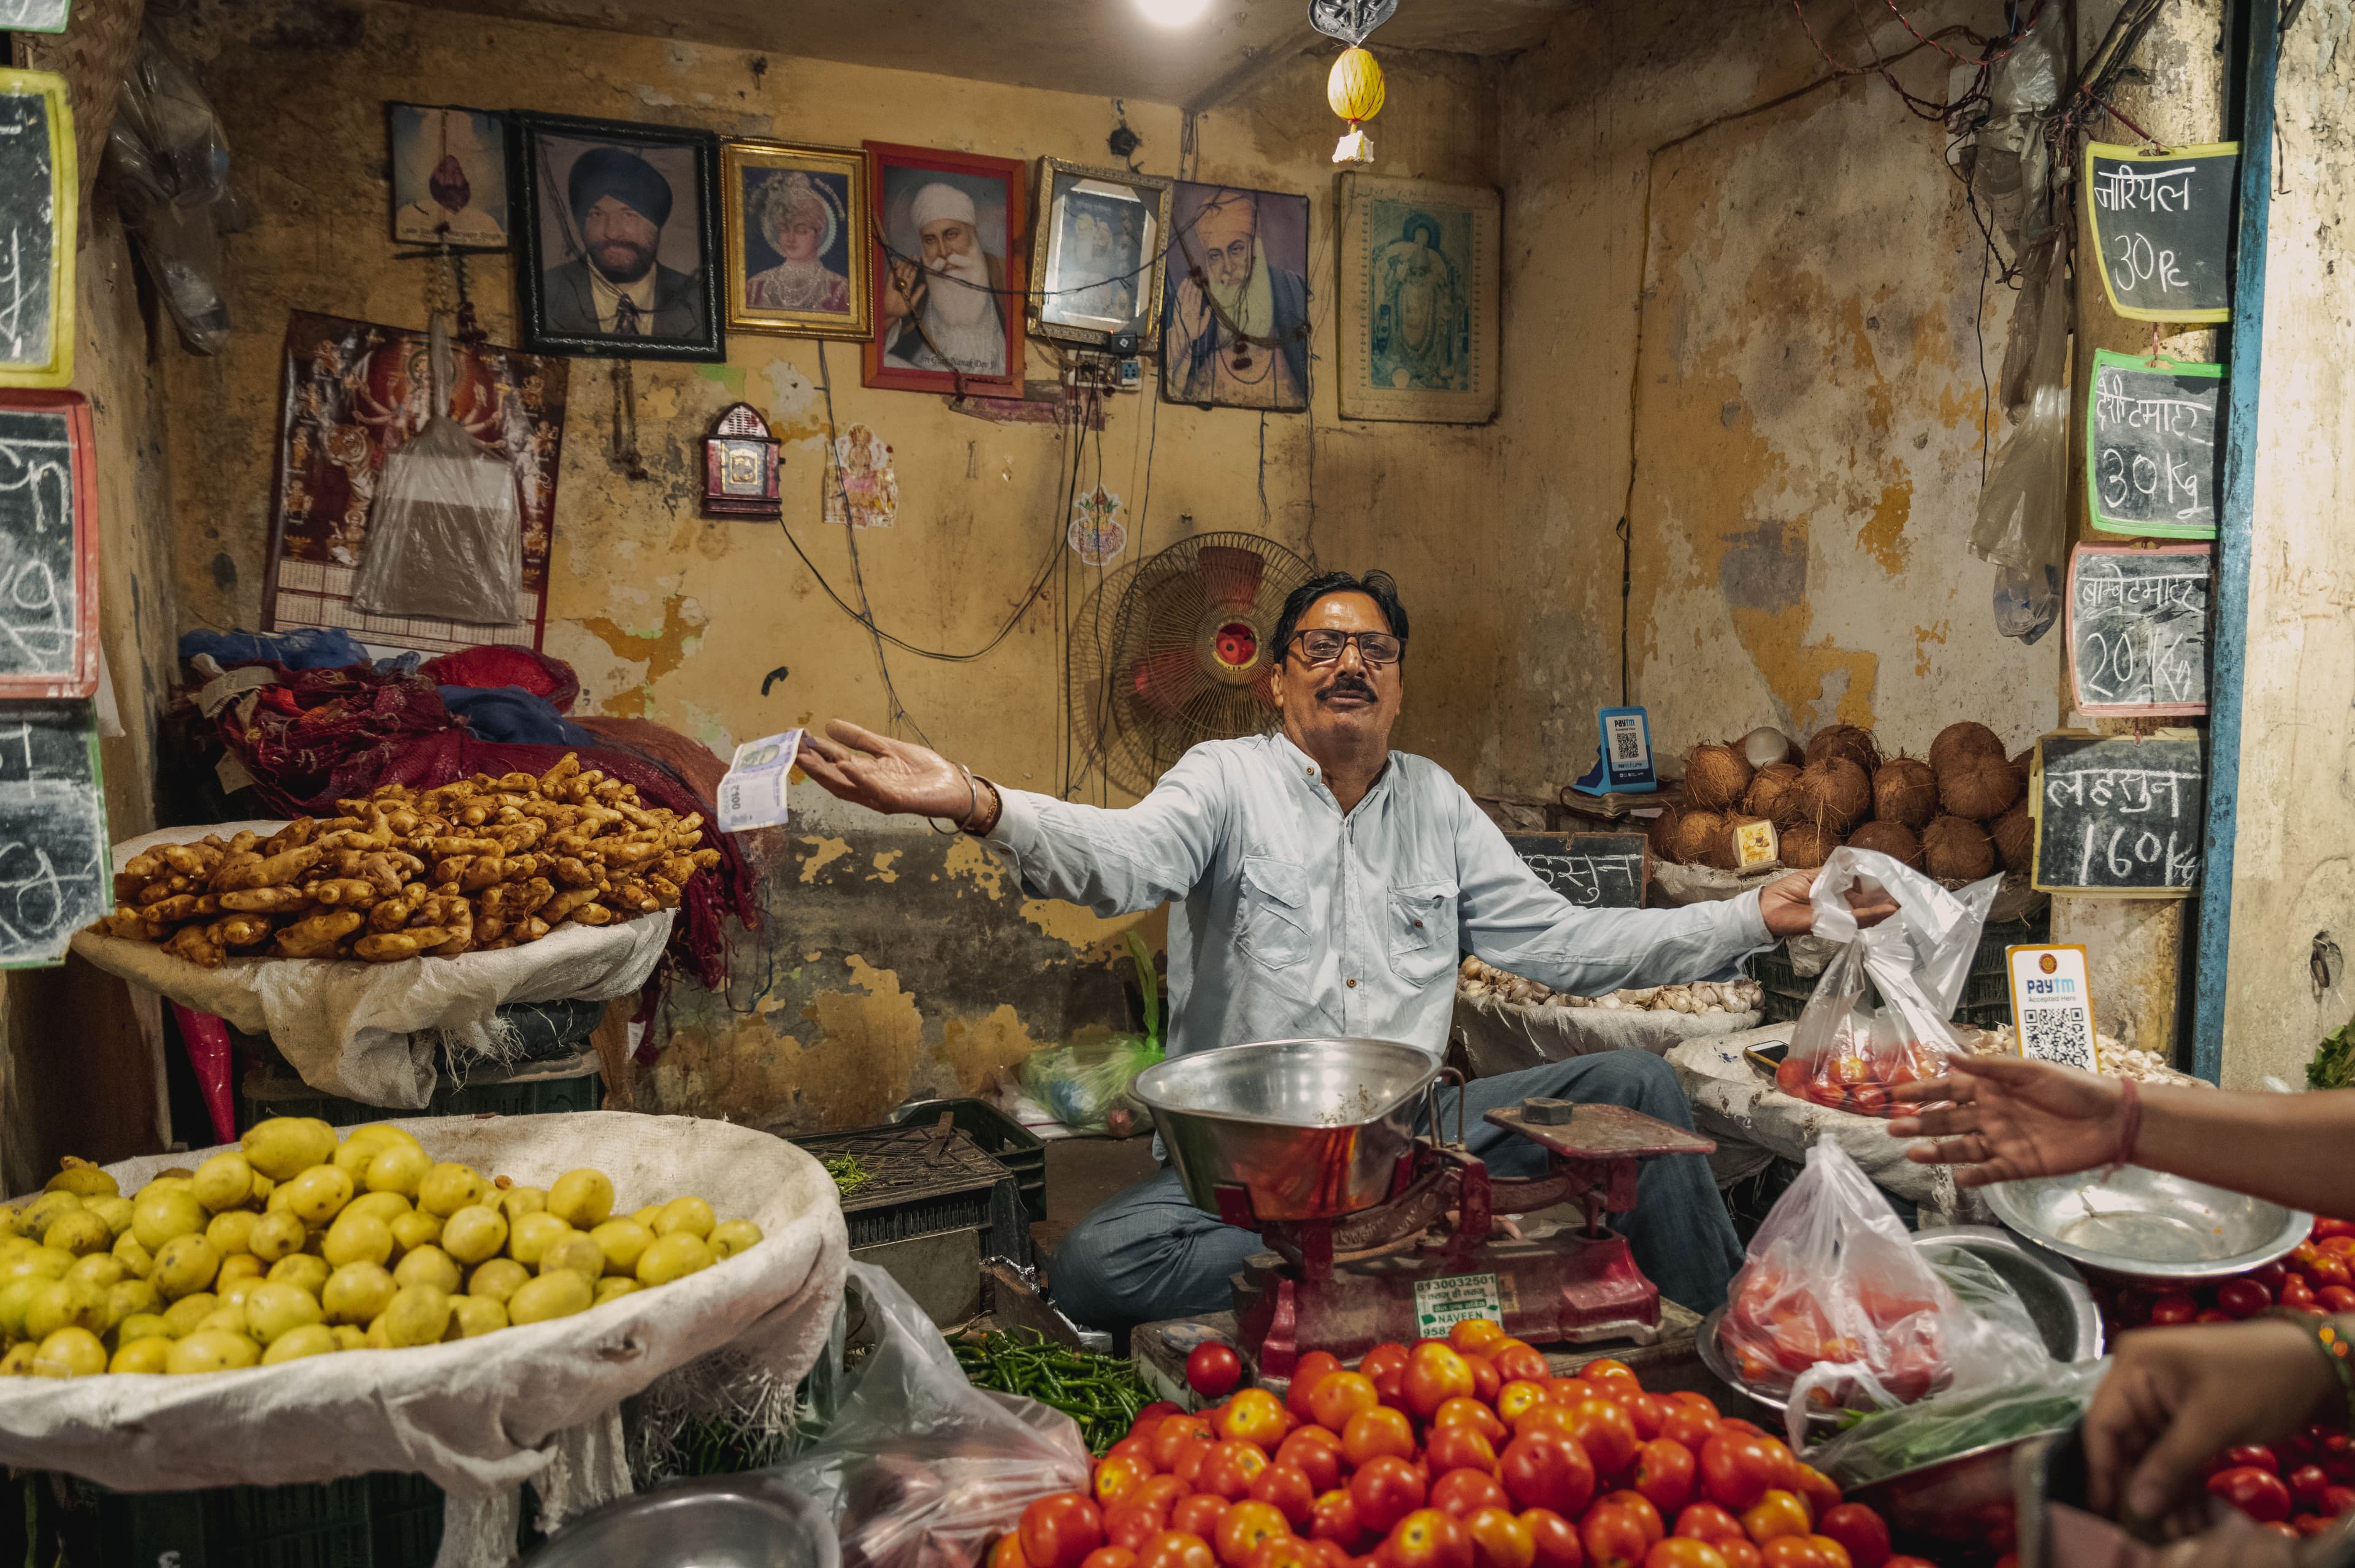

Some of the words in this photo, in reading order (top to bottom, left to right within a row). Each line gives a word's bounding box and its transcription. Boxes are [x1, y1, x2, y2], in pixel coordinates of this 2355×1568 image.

[2094, 165, 2196, 212] नारियल
[2047, 768, 2202, 817] लहसुन
[1417, 1275, 1495, 1292] 8130032501
